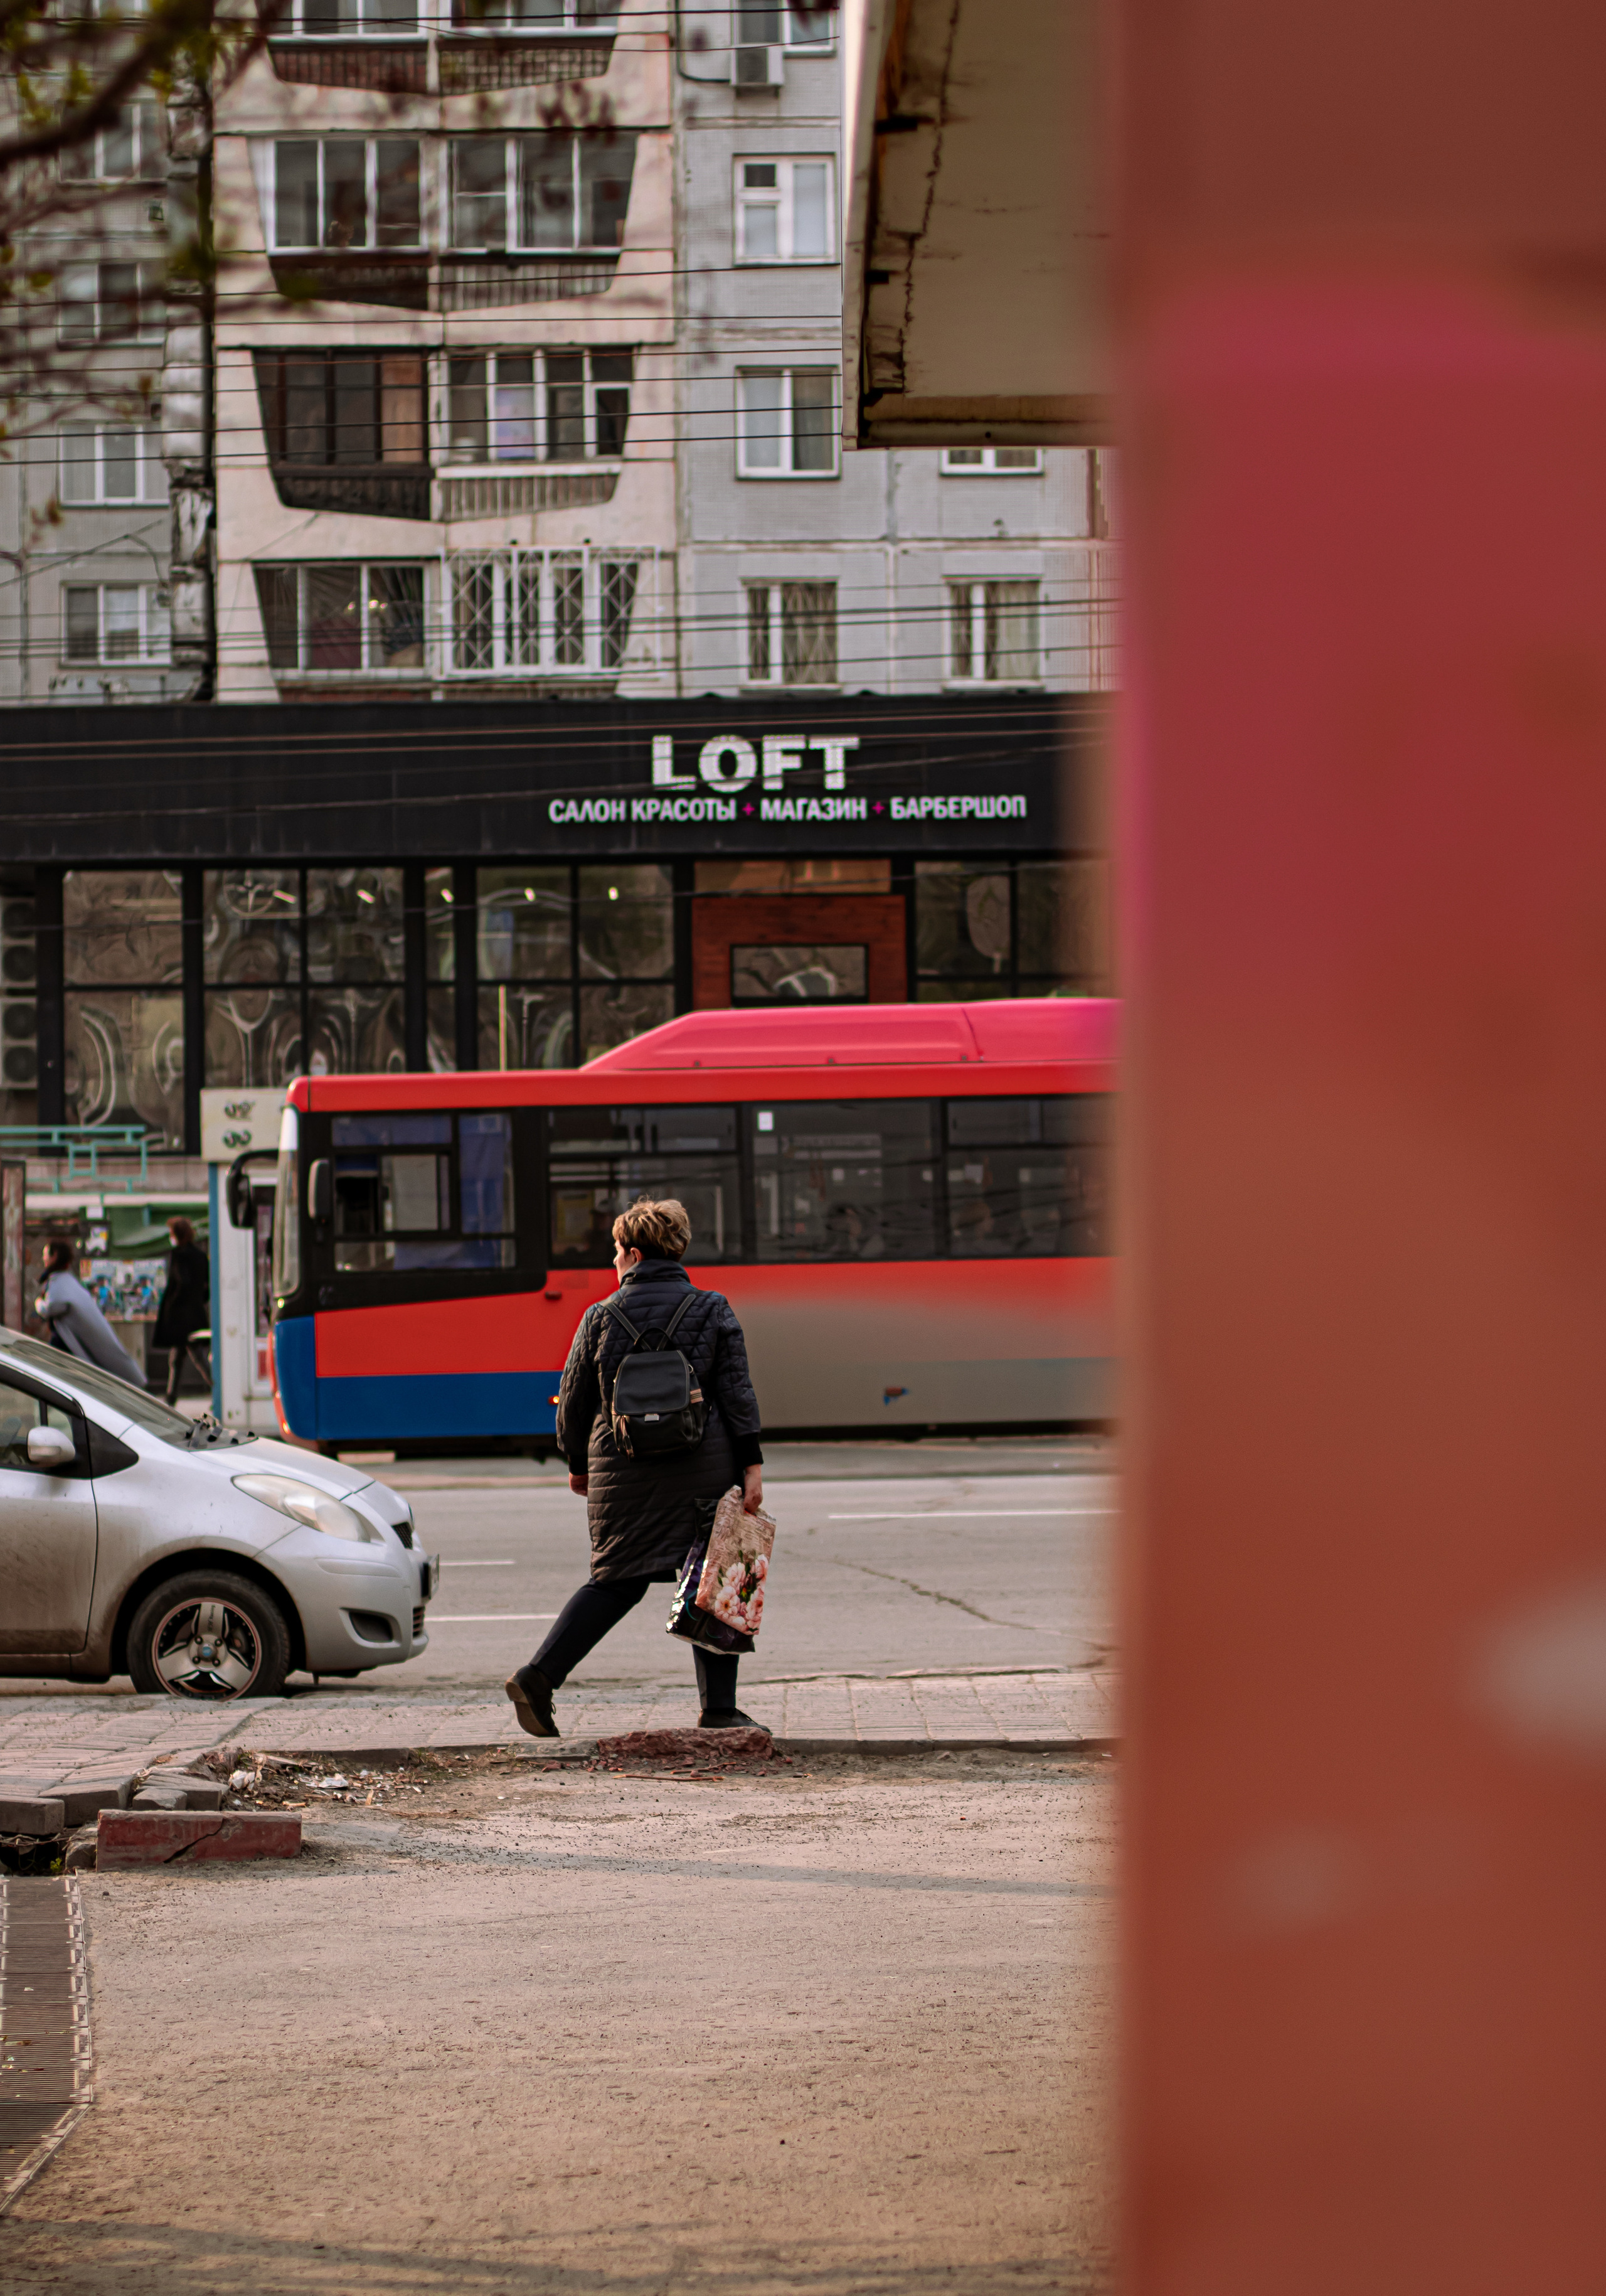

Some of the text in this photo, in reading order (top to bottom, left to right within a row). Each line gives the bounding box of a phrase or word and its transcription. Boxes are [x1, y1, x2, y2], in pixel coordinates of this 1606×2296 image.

[652, 735, 859, 792] LOFT
[549, 794, 1027, 823] САЛОН КРАСОТЫ МАГАЗИН БАРБЕРШОП
